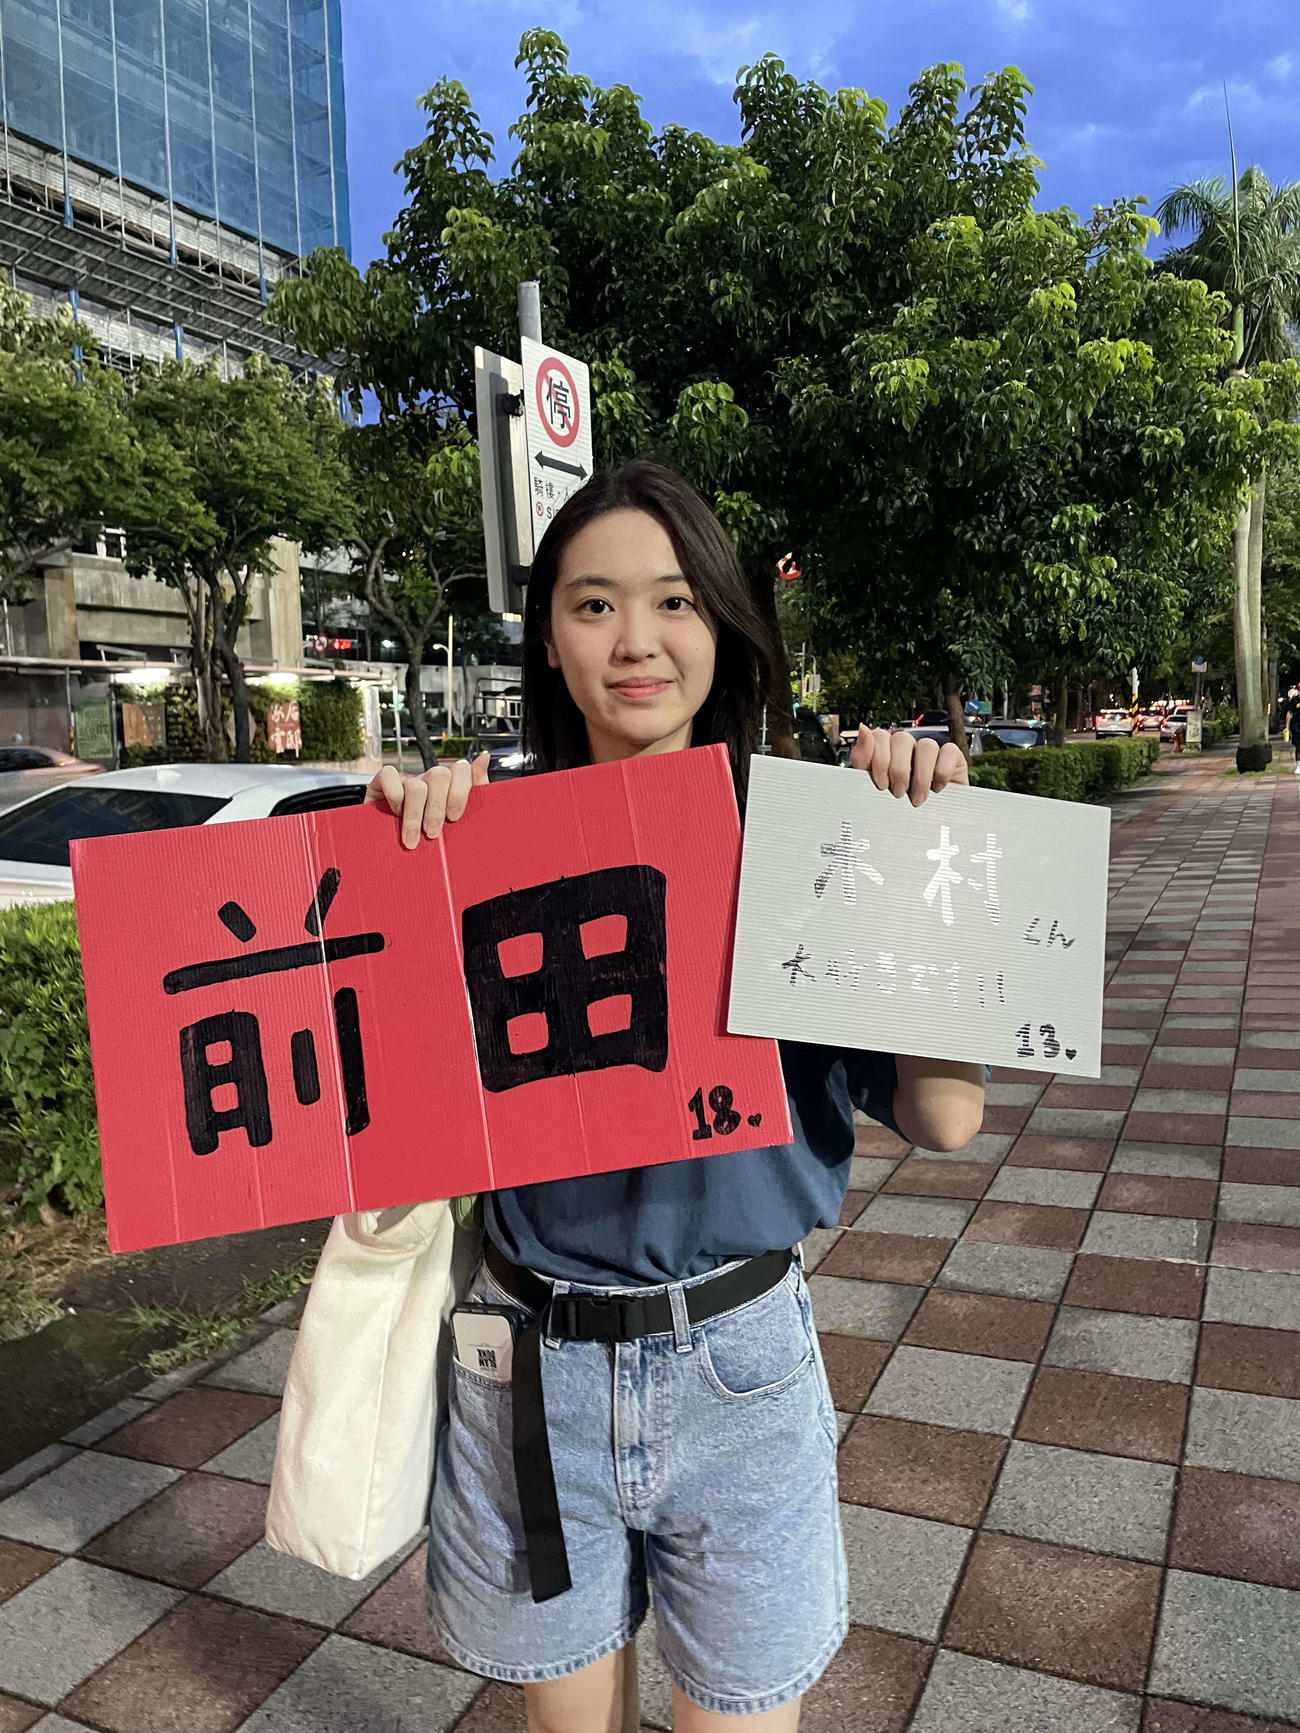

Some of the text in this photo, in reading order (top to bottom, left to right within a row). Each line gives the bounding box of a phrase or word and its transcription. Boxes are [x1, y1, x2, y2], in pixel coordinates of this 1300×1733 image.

[546, 377, 571, 429] 停
[813, 820, 1003, 926] 木村
[163, 865, 669, 1155] 前田
